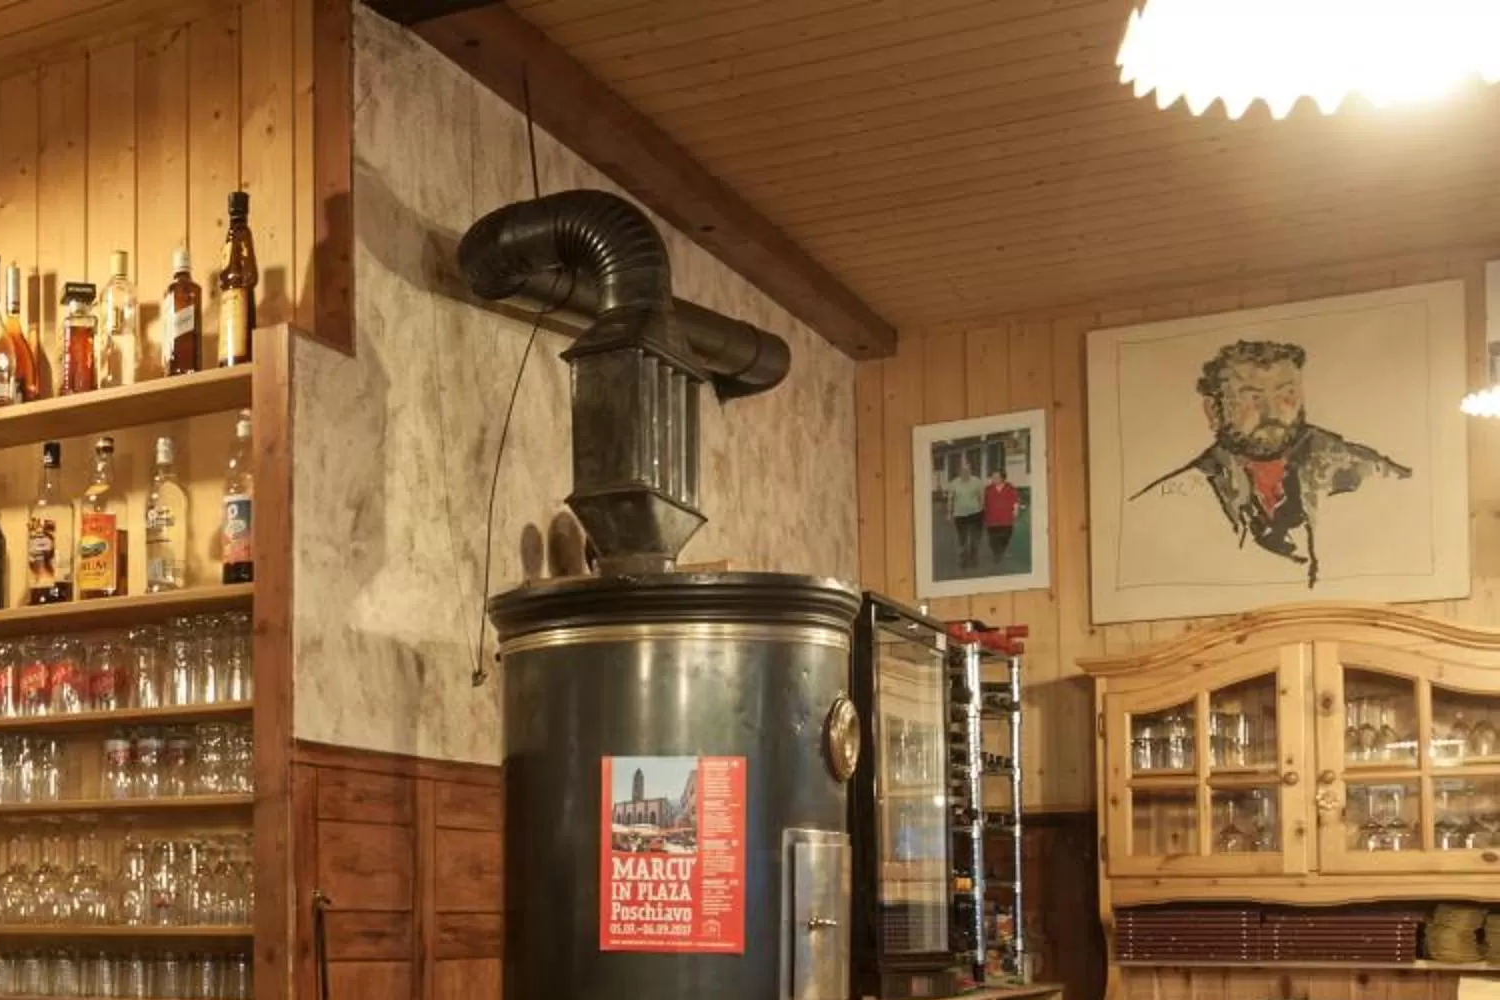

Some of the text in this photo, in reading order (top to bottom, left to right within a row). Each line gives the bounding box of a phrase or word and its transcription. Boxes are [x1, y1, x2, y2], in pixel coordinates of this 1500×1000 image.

[611, 882, 692, 901] IN PLAZA
[611, 901, 693, 922] Poschiavo
